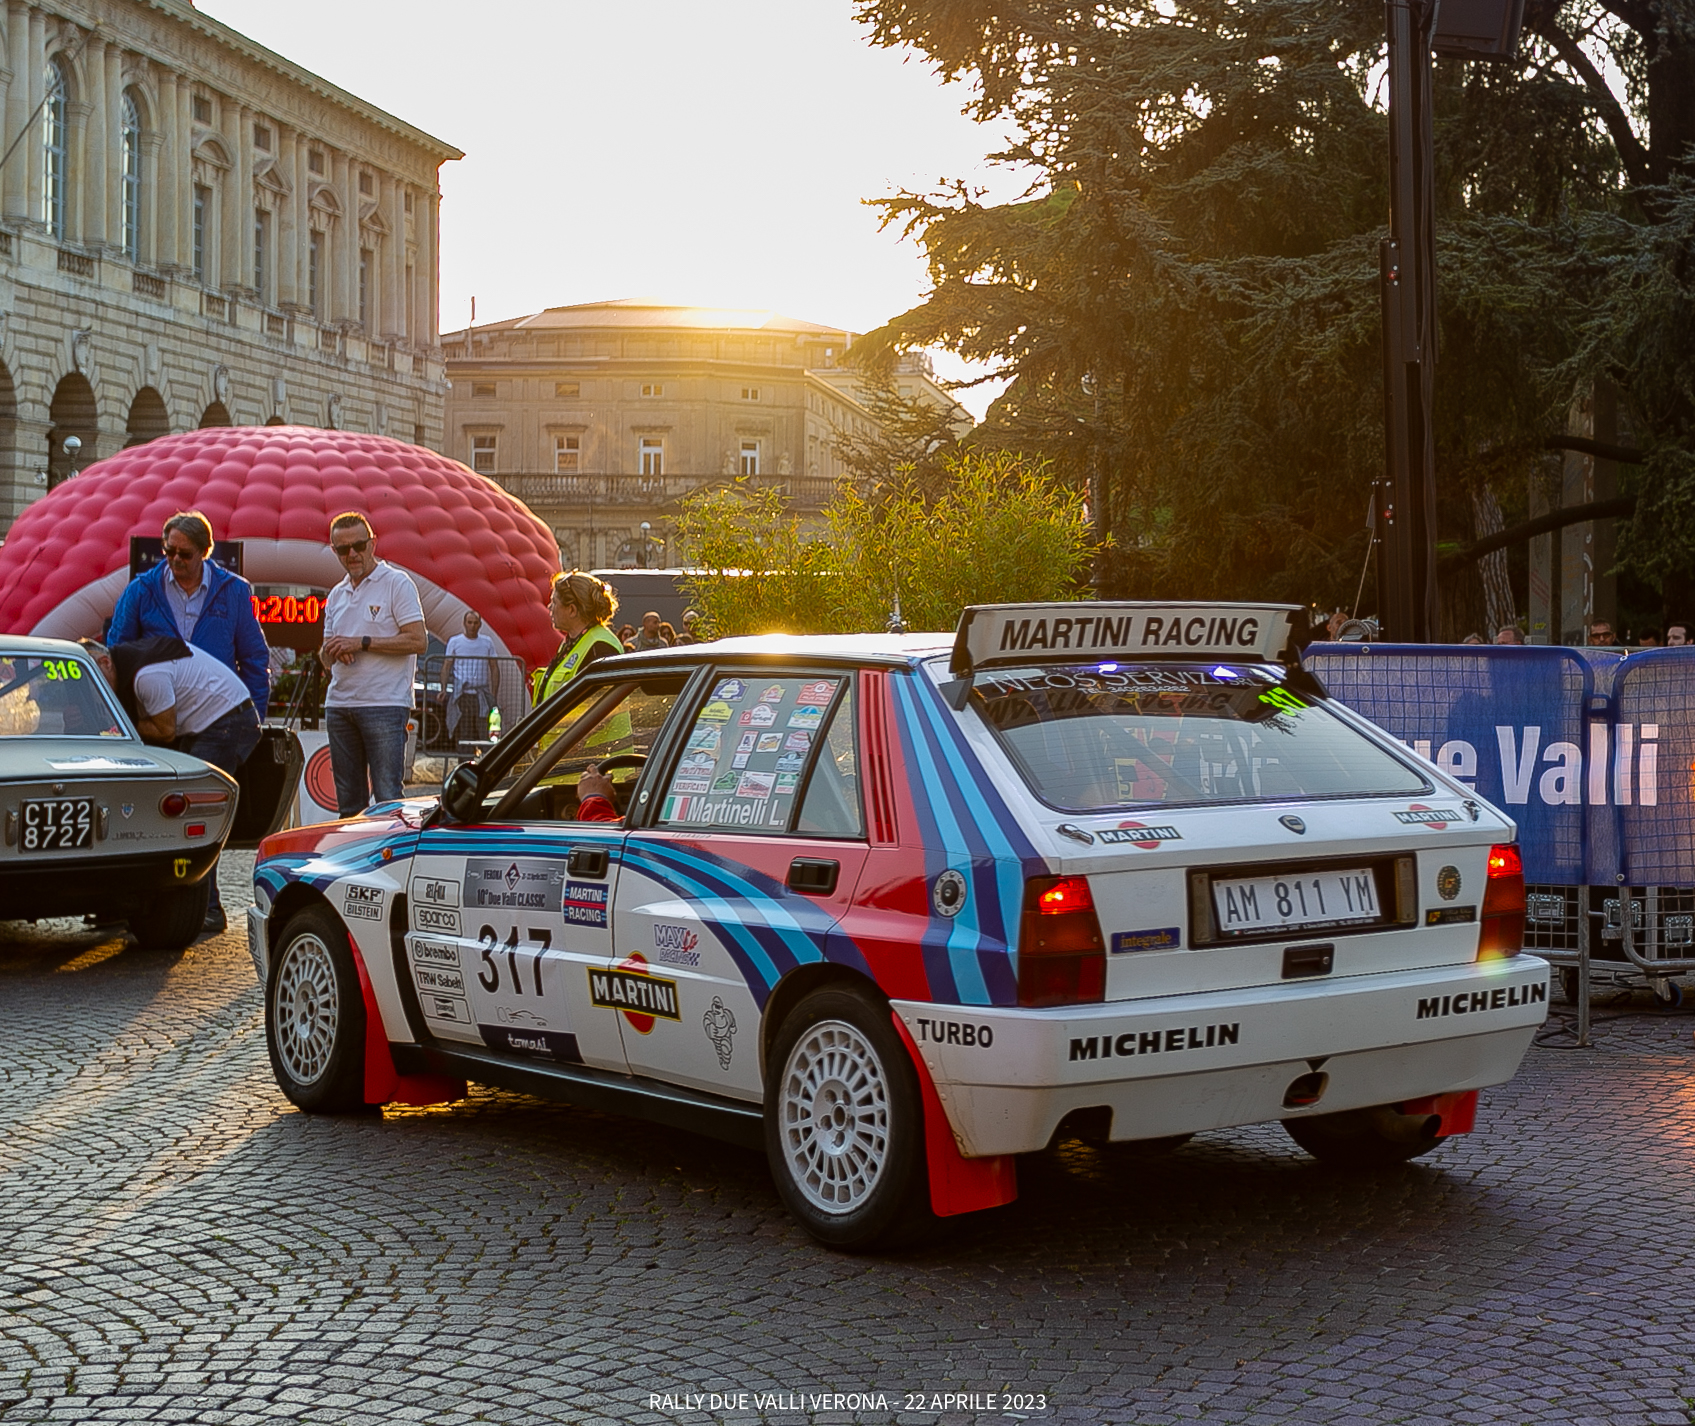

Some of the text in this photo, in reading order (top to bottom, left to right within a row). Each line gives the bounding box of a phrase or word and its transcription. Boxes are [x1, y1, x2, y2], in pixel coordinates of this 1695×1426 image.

[251, 595, 329, 623] :20:0
[1000, 616, 1259, 650] MARTINI RACING
[43, 660, 82, 680] 316
[986, 673, 1097, 693] NEOS
[1495, 723, 1659, 806] Valli
[25, 802, 90, 826] CT22
[687, 796, 785, 826] Martinelli L.
[1399, 809, 1459, 825] MARTINI
[24, 823, 90, 848] 8727
[1100, 826, 1179, 844] MARTINI
[348, 886, 381, 902] SKF
[517, 892, 546, 908] CLASSIC
[569, 886, 603, 901] MARTINI
[1226, 875, 1374, 923] AM 811 YM
[347, 904, 379, 918] BILSTEIN
[420, 909, 456, 928] sparco
[568, 907, 601, 922] RACING
[1120, 931, 1172, 949] integrale
[423, 943, 456, 961] brembo
[477, 923, 552, 997] 317
[417, 971, 436, 986] TRW
[592, 974, 677, 1014] MARTINI
[1416, 982, 1548, 1020] MICHELIN
[917, 1018, 994, 1048] TURBO
[1068, 1022, 1241, 1062] MICHELIN
